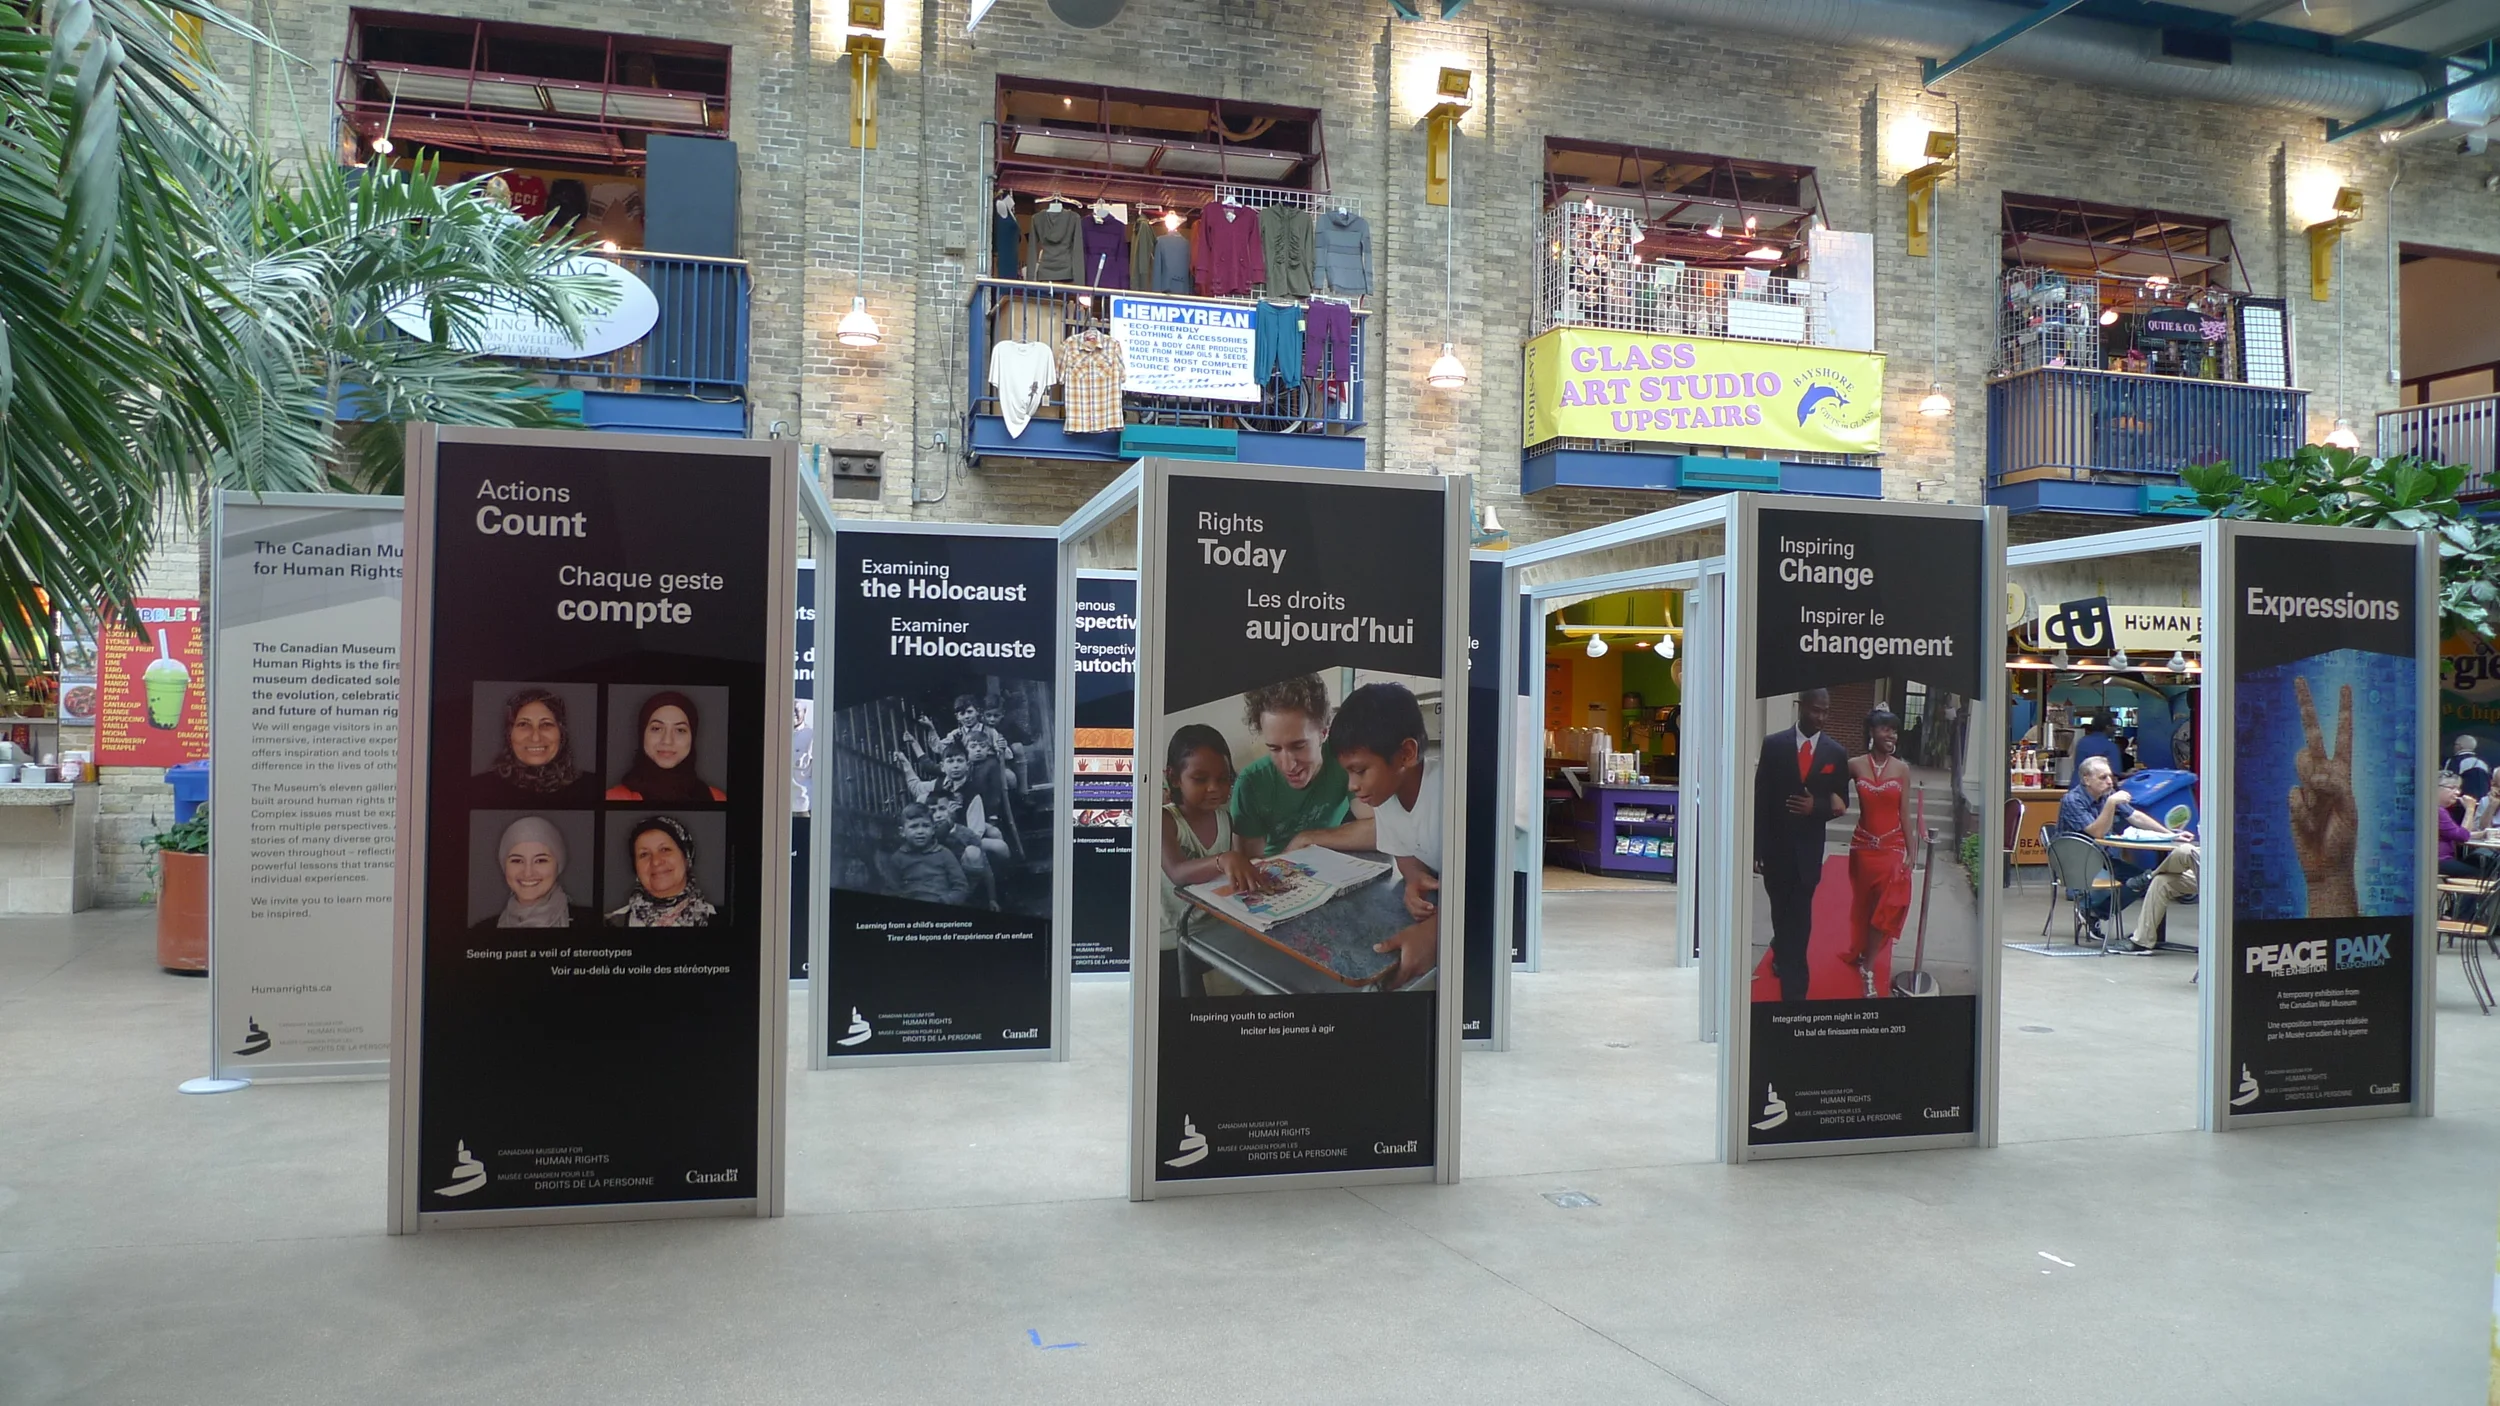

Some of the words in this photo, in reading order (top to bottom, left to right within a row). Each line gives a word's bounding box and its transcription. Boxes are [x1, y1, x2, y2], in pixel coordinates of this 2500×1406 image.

[1122, 303, 1249, 328] HEMPYREAN
[1129, 323, 1199, 333] ECO-FRIENDLY
[2148, 320, 2174, 331] QUTIE
[2175, 323, 2182, 331] &
[2183, 324, 2197, 332] CO.
[1129, 330, 1173, 339] CLOTHING
[1188, 334, 1248, 344] ACCESSORIES
[1209, 345, 1248, 353] PRODUCTS
[1129, 354, 1169, 363] NATURES
[1174, 358, 1197, 366] MOST
[1202, 360, 1248, 369] COMPLETE
[1571, 343, 1696, 372] GLASS
[1130, 362, 1169, 371] SOURCE
[1190, 367, 1232, 376] PROTEIN
[1793, 368, 1854, 392] BAYSHORE
[1526, 346, 1536, 444] BAYSHORE
[1559, 378, 1631, 407] ART
[1639, 371, 1781, 402] STUDIO
[1612, 404, 1762, 432] UPSTAIRS
[1850, 410, 1874, 429] GLASS
[477, 479, 570, 503] Actions
[477, 505, 586, 538] Count
[1198, 511, 1264, 536] Rights
[254, 541, 286, 555] The
[292, 542, 371, 557] Canadian
[1198, 538, 1287, 574] Today
[1780, 536, 1855, 560] Inspiring
[254, 562, 277, 575] for
[283, 563, 344, 577] Human
[351, 564, 403, 580] Rights
[862, 559, 949, 579] Examining
[1779, 558, 1873, 591] Change
[559, 565, 652, 591] Chaque
[659, 571, 724, 593] geste
[861, 578, 901, 598] the
[908, 579, 1027, 601] Holocaust
[1247, 588, 1281, 608] Les
[1287, 591, 1345, 610] droits
[2247, 587, 2399, 623] Expressions
[558, 597, 692, 629] compte
[1801, 606, 1865, 628] Inspirer
[1870, 608, 1884, 626] le
[892, 617, 969, 633] Examiner
[253, 643, 276, 653] The
[280, 643, 338, 654] Canadian
[342, 644, 396, 654] Museum
[1800, 629, 1953, 660] changement
[253, 658, 298, 669] Human
[302, 659, 342, 671] Rights
[346, 659, 356, 669] is
[359, 660, 379, 670] the
[253, 676, 307, 685] museum
[312, 675, 371, 685] dedicated
[252, 691, 273, 700] the
[276, 691, 339, 702] evolution,
[252, 706, 275, 716] and
[279, 706, 316, 716] future
[320, 705, 333, 716] of
[336, 706, 379, 717] human
[2020, 839, 2044, 847] BEA
[856, 921, 887, 930] Learning
[888, 921, 905, 929] from
[935, 921, 973, 930] experience
[466, 950, 502, 960] Seeing
[505, 950, 527, 960] past
[540, 948, 558, 958] veil
[560, 948, 571, 958] of
[573, 948, 632, 959] stereotypes
[2246, 940, 2328, 973] PEACE
[2335, 934, 2392, 964] PAIX
[552, 966, 571, 976] Voir
[574, 966, 610, 976] au-delà
[612, 966, 626, 975] du
[628, 965, 652, 974] voile
[654, 965, 672, 974] des
[674, 964, 730, 976] stéréotypes
[2271, 970, 2284, 978] THE
[2286, 964, 2328, 976] EXHIBITION
[251, 985, 332, 995] Humanrights.ca
[1190, 1012, 1228, 1023] Inspiring
[1230, 1011, 1256, 1023] youth
[1257, 1011, 1267, 1021] to
[1269, 1010, 1295, 1020] action
[1773, 1015, 1811, 1024] Integrating
[1813, 1015, 1832, 1024] prom
[1833, 1013, 1852, 1022] night
[1862, 1012, 1879, 1020] 2013
[1003, 1028, 1038, 1039] Canada
[1240, 1026, 1267, 1036] Inciter
[1269, 1026, 1281, 1035] les
[1282, 1026, 1310, 1036] jeunes
[1312, 1024, 1317, 1034] à
[1319, 1024, 1335, 1035] agir
[1806, 1029, 1816, 1037] bal
[1827, 1028, 1859, 1036] finissants
[1860, 1027, 1879, 1035] mixte
[1890, 1026, 1906, 1034] 2013
[2370, 1083, 2400, 1095] Canada
[1923, 1105, 1960, 1119] Canada
[1374, 1140, 1418, 1155] Canada
[535, 1157, 572, 1167] HUMAN
[574, 1154, 610, 1164] RIGHTS
[685, 1168, 738, 1185] Canada
